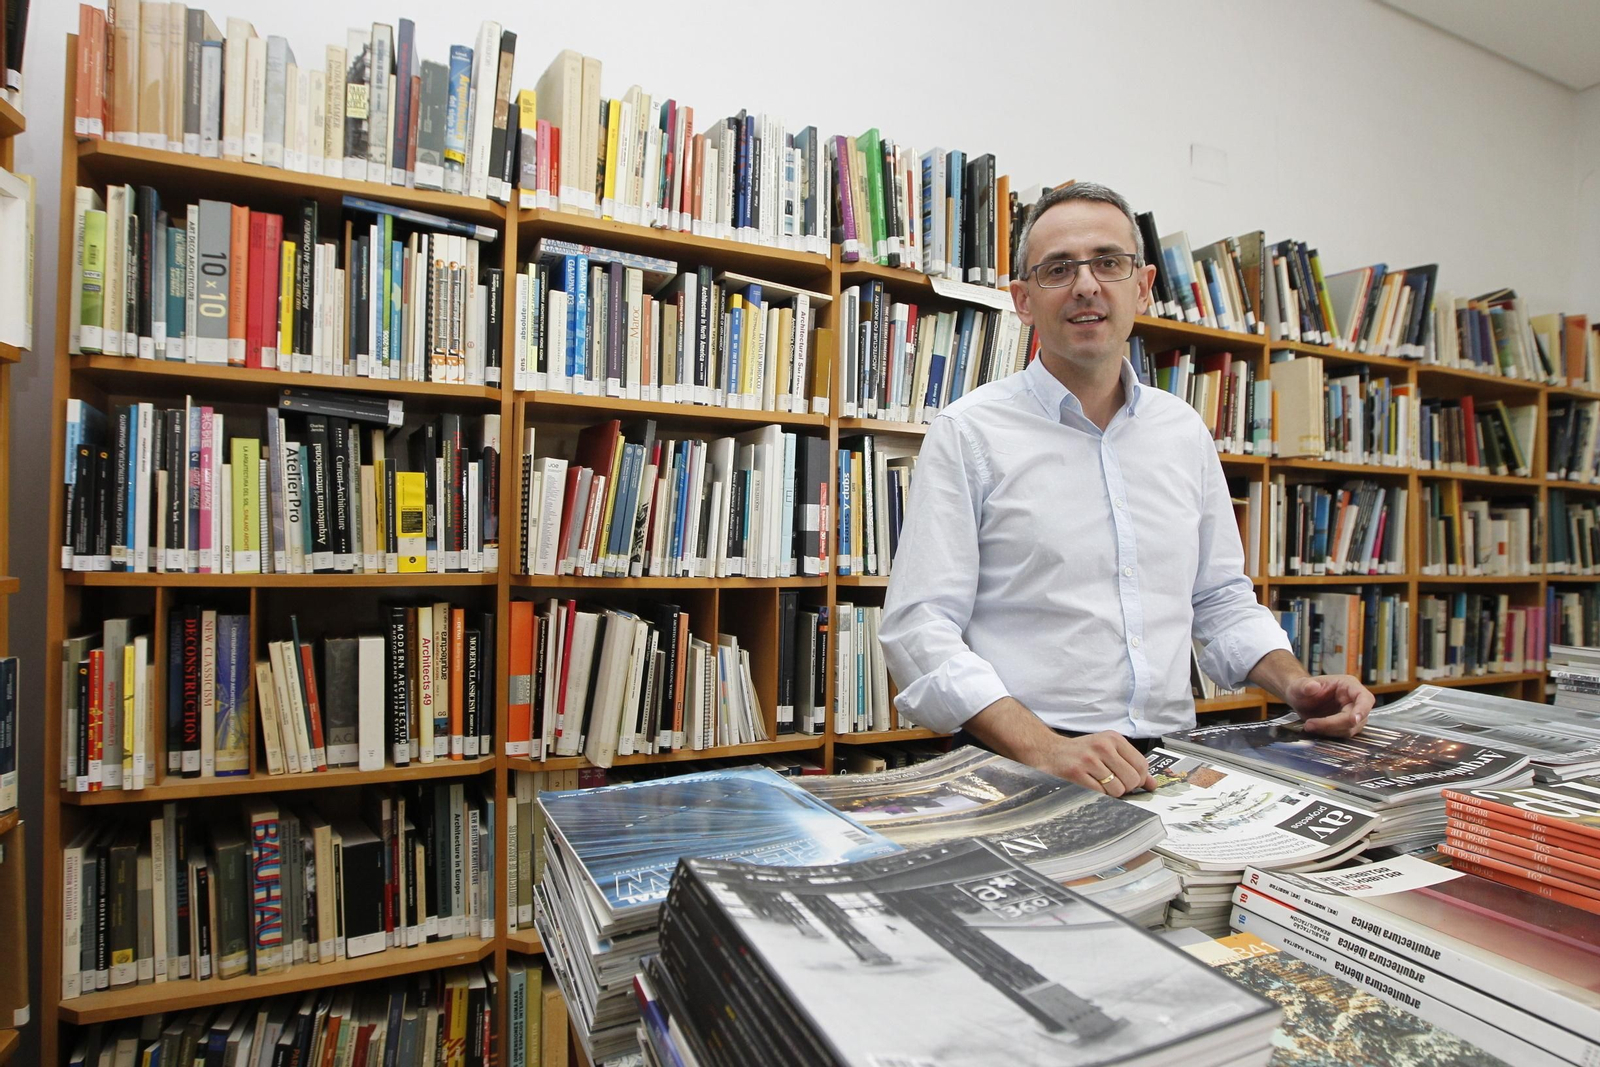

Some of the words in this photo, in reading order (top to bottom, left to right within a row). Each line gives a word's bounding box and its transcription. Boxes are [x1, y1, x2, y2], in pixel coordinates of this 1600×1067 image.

[333, 60, 341, 93] INDIAN
[333, 96, 341, 128] SUMMER
[455, 75, 469, 140] Arquitectura
[303, 219, 311, 251] OVERVIEW
[201, 253, 227, 277] 10
[303, 253, 310, 262] AN
[206, 280, 217, 288] x
[302, 263, 310, 309] ARCHITECTURE:
[567, 294, 574, 305] 03
[578, 293, 586, 305] 04
[200, 293, 226, 318] 10
[630, 306, 639, 338] Maroc
[798, 311, 806, 360] Architectural
[192, 453, 198, 461] 2
[286, 448, 299, 497] Atelier
[313, 443, 323, 494] internacional
[336, 455, 345, 482] Current
[289, 499, 301, 523] Pro
[315, 495, 327, 544] Arquitectura
[337, 485, 346, 530] Architecture
[843, 502, 850, 510] y
[205, 620, 213, 642] NEW
[422, 638, 431, 690] Architects
[439, 632, 448, 680] arquitectura
[468, 636, 476, 669] MODERN
[184, 619, 198, 743] DECONSTRUCTION
[204, 648, 213, 707] CLASSICISM
[468, 670, 476, 713] CLASSICISM
[423, 693, 432, 706] 49
[470, 812, 478, 823] NEW
[1291, 805, 1328, 830] proyectos
[1446, 790, 1457, 799] au
[1523, 811, 1538, 821] 468
[1451, 801, 1462, 810] au
[1531, 823, 1546, 832] 467
[1307, 810, 1354, 840] av
[1000, 834, 1049, 856] AV
[471, 848, 479, 886] ARCHITECTURE
[509, 862, 516, 870] DE
[1442, 845, 1454, 856] au
[1526, 871, 1542, 882] 462
[454, 869, 462, 895] Europe
[509, 871, 517, 907] ARQUITECTOS
[1250, 873, 1260, 885] 20
[1351, 916, 1383, 939] ibérica
[1383, 929, 1441, 961] arquitectura
[1240, 893, 1249, 904] 19
[1337, 937, 1368, 960] ibérica
[1368, 952, 1426, 984] arquitectura
[1238, 914, 1247, 925] 16
[1283, 938, 1305, 953] HABITAR
[1305, 948, 1327, 963] HABITAR
[1334, 961, 1364, 984] ibérica
[1365, 976, 1421, 1010] arquitectura
